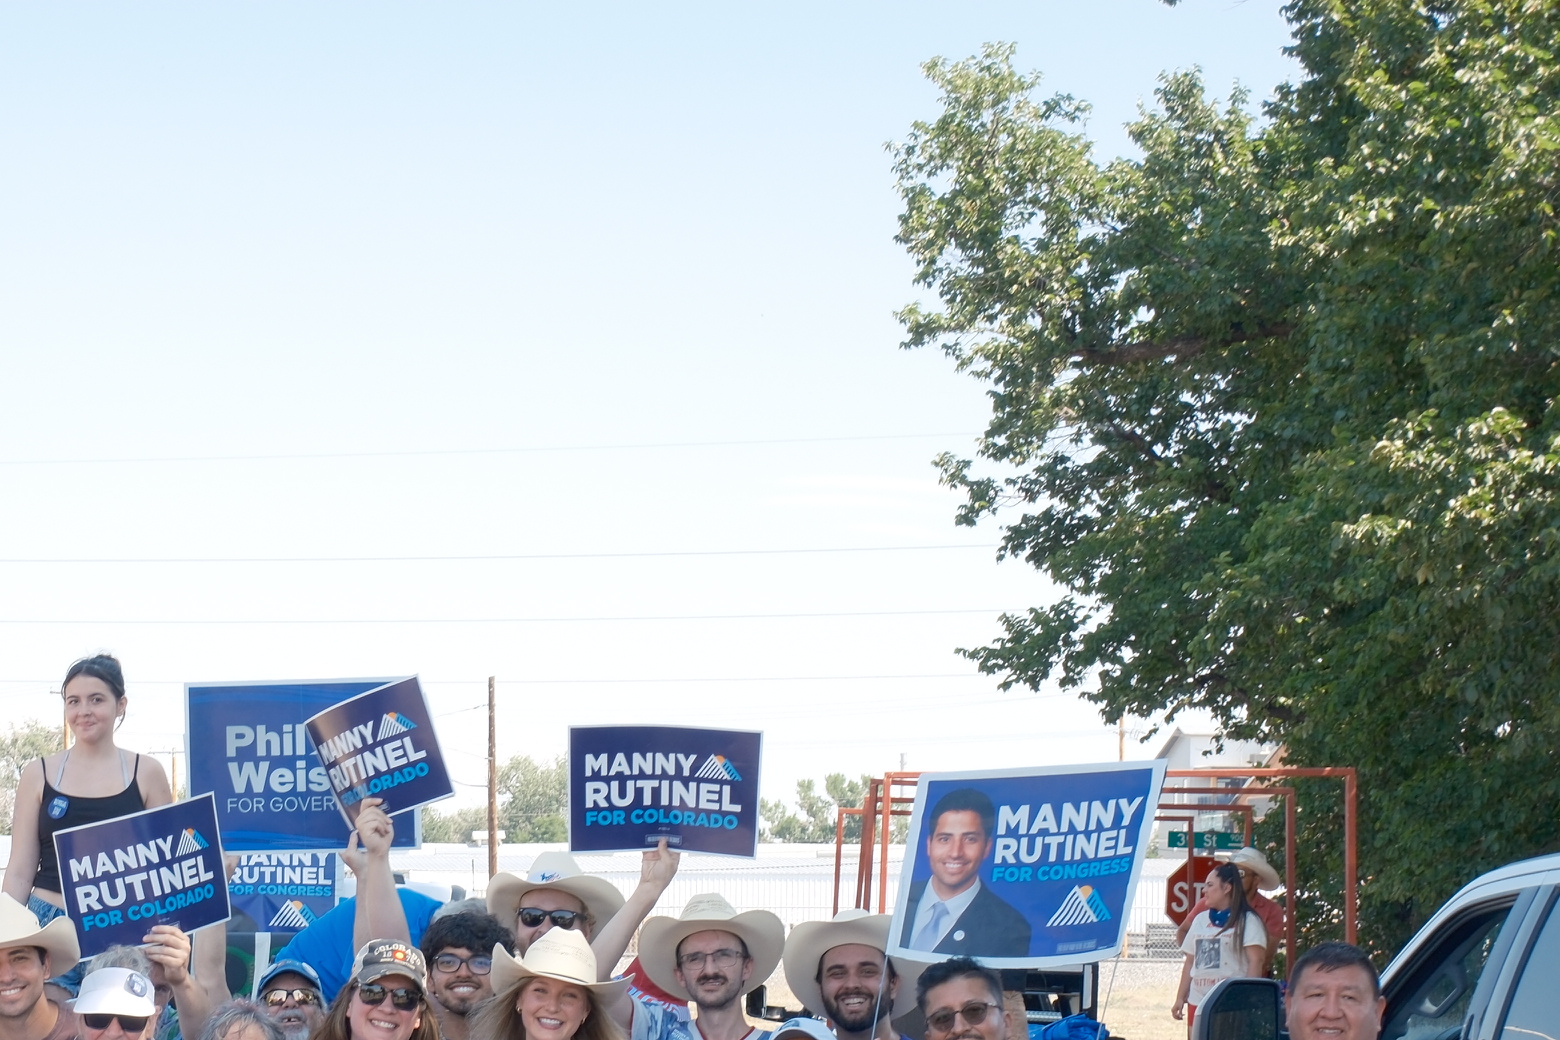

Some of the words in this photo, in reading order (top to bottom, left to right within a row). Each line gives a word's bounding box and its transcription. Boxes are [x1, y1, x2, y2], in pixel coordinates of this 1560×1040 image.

[226, 724, 307, 758] Phil
[318, 720, 375, 764] MANNY
[227, 760, 331, 794] Weis
[329, 736, 427, 793] RUTINEL
[585, 752, 698, 777] MANNY
[227, 797, 264, 813] FOR
[270, 796, 340, 813] GOVER
[585, 780, 741, 812] RUTINEL
[586, 810, 625, 826] FOR
[631, 808, 738, 830] COLORADO
[997, 796, 1144, 835] MANNY
[994, 828, 1133, 864] RUTINEL
[1203, 834, 1217, 847] St
[69, 835, 173, 882] MANNY
[992, 866, 1033, 883] FOR
[1037, 857, 1130, 881] CONGRESS
[75, 855, 214, 914] RUTINEL
[228, 885, 254, 895] FOR
[257, 885, 332, 897] CONGRESS
[229, 866, 332, 885] RUTINEL
[82, 909, 124, 932] FOR
[128, 883, 215, 921] COLORADO
[1171, 881, 1206, 913] ST
[374, 943, 422, 966] COLORADO
